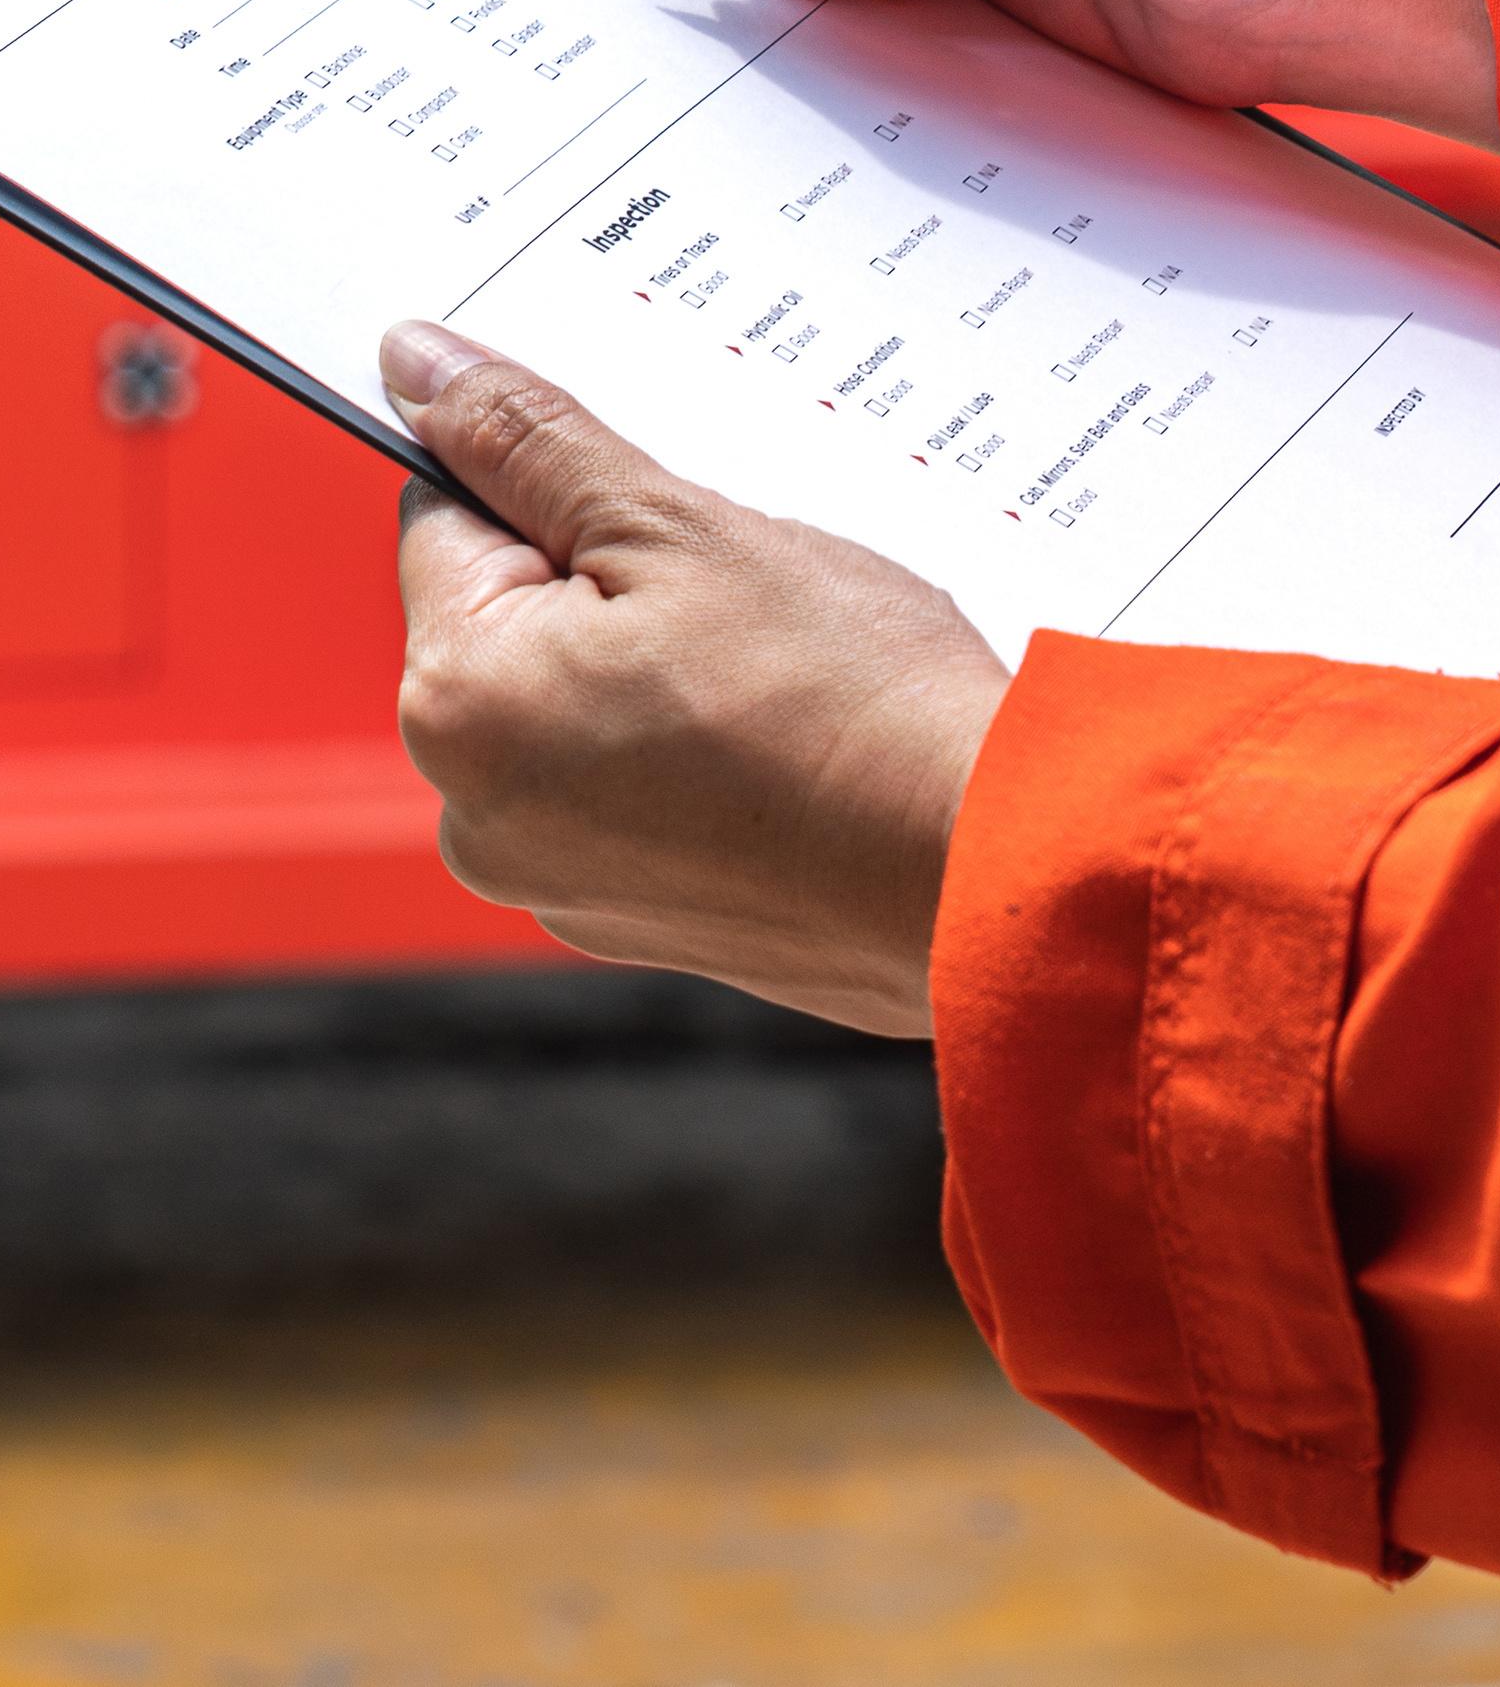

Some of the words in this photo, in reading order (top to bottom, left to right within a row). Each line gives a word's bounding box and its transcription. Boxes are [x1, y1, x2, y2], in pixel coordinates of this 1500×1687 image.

[169, 30, 200, 49] Date
[219, 58, 251, 77] Time
[408, 86, 458, 124] Compactor
[226, 107, 285, 150] Equipment
[276, 90, 308, 110] Type
[449, 126, 483, 148] Crane
[796, 183, 830, 208] Needs
[455, 203, 484, 223] Unit
[582, 189, 671, 253] Inspection
[682, 233, 719, 258] Tracks
[886, 236, 920, 261] Needs
[675, 256, 691, 268] or
[649, 266, 681, 287] Tires
[698, 270, 729, 294] Good
[977, 290, 1011, 315] Needs
[742, 304, 790, 342] Hydraulic
[782, 290, 803, 305] Oil
[789, 325, 820, 348] Good
[833, 373, 864, 396] Hose
[857, 336, 904, 374] Condition
[1068, 342, 1102, 369] Needs
[882, 379, 913, 403] Good
[1160, 395, 1193, 421] Needs
[1375, 399, 1416, 436] INSPECTED
[1407, 387, 1425, 402] BY
[927, 434, 948, 450] Oil
[939, 416, 968, 438] Leak
[964, 393, 994, 415] Lube
[974, 434, 1005, 458] Good
[1020, 487, 1048, 505] Cab,
[1038, 456, 1079, 487] Mirrors,
[1069, 435, 1097, 457] Seat
[1087, 419, 1114, 439] Belt
[1107, 403, 1129, 422] and
[1121, 383, 1151, 406] Glass
[1067, 488, 1098, 512] Good
